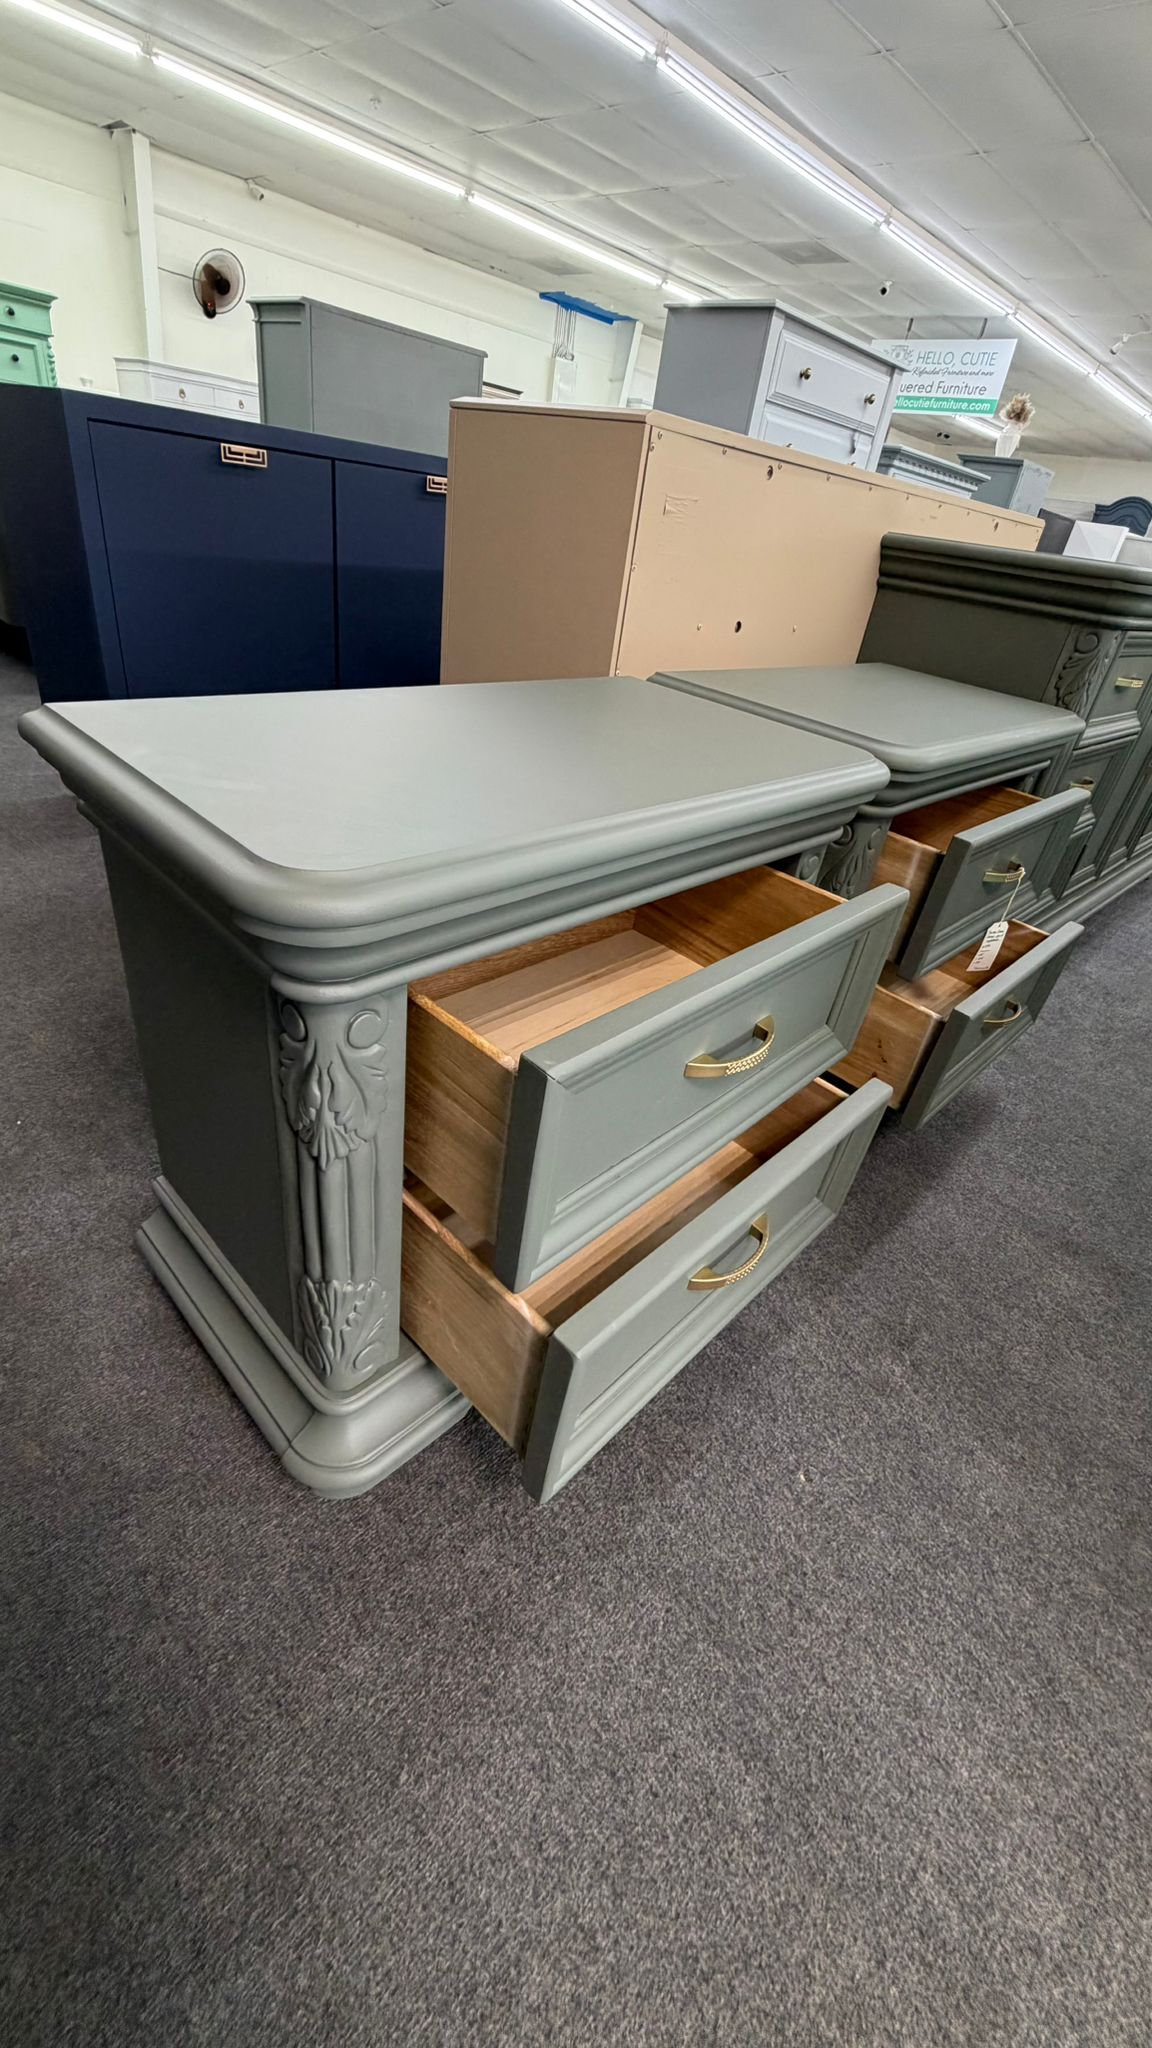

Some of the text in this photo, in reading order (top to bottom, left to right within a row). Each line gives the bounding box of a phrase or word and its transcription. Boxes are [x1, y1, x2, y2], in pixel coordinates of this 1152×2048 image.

[916, 351, 998, 367] HELLO, CUTIE
[899, 381, 987, 396] uered Furniture
